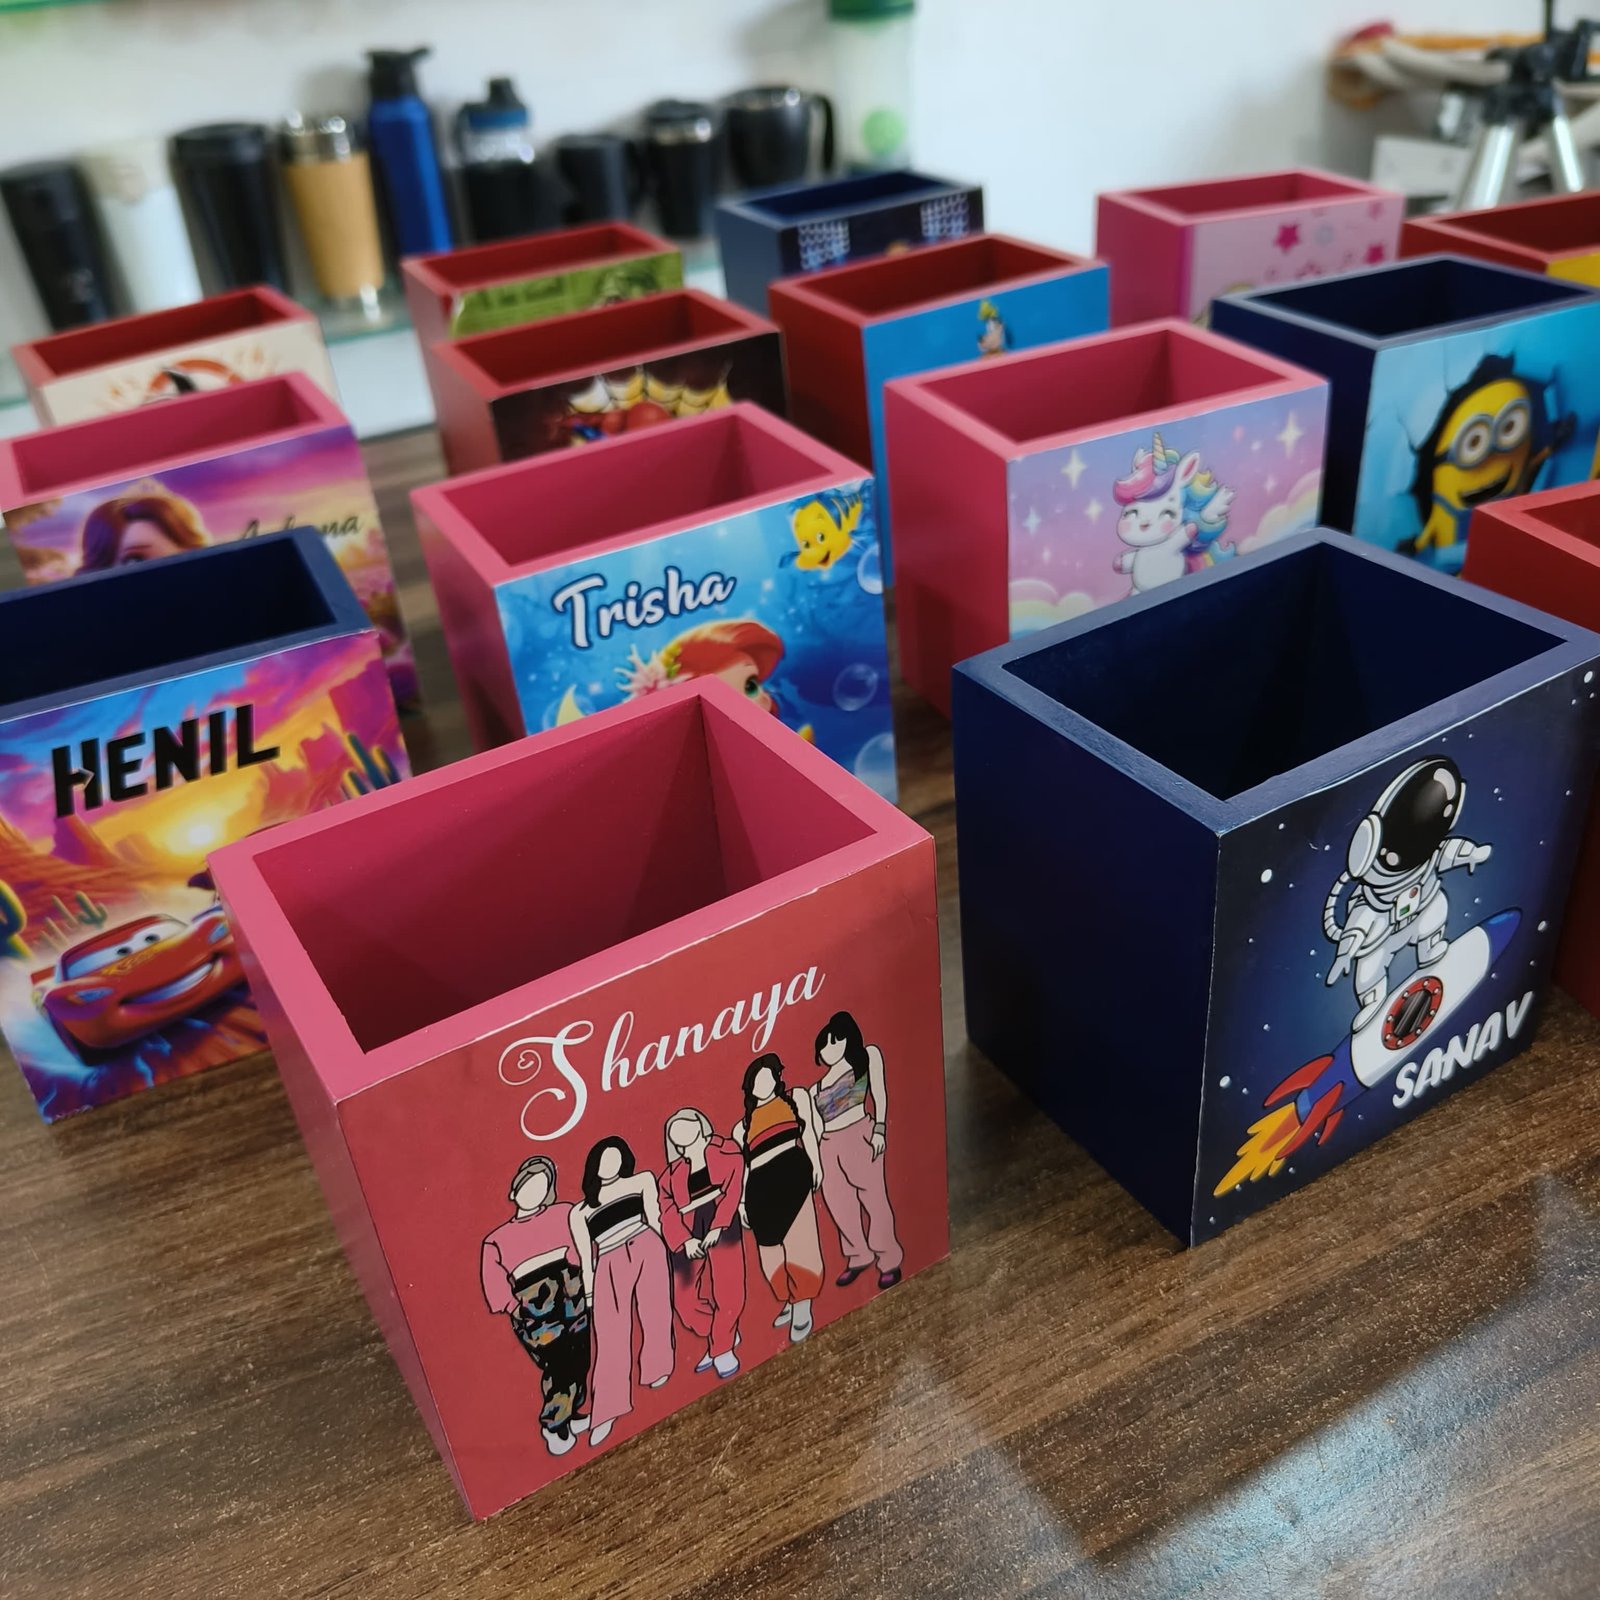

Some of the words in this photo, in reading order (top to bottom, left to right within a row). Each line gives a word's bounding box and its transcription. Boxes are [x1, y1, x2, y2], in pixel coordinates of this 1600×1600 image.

[552, 565, 737, 648] Trisha
[51, 703, 280, 819] HENIL
[498, 966, 826, 1141] Shanaya
[1392, 990, 1534, 1109] SANAV
